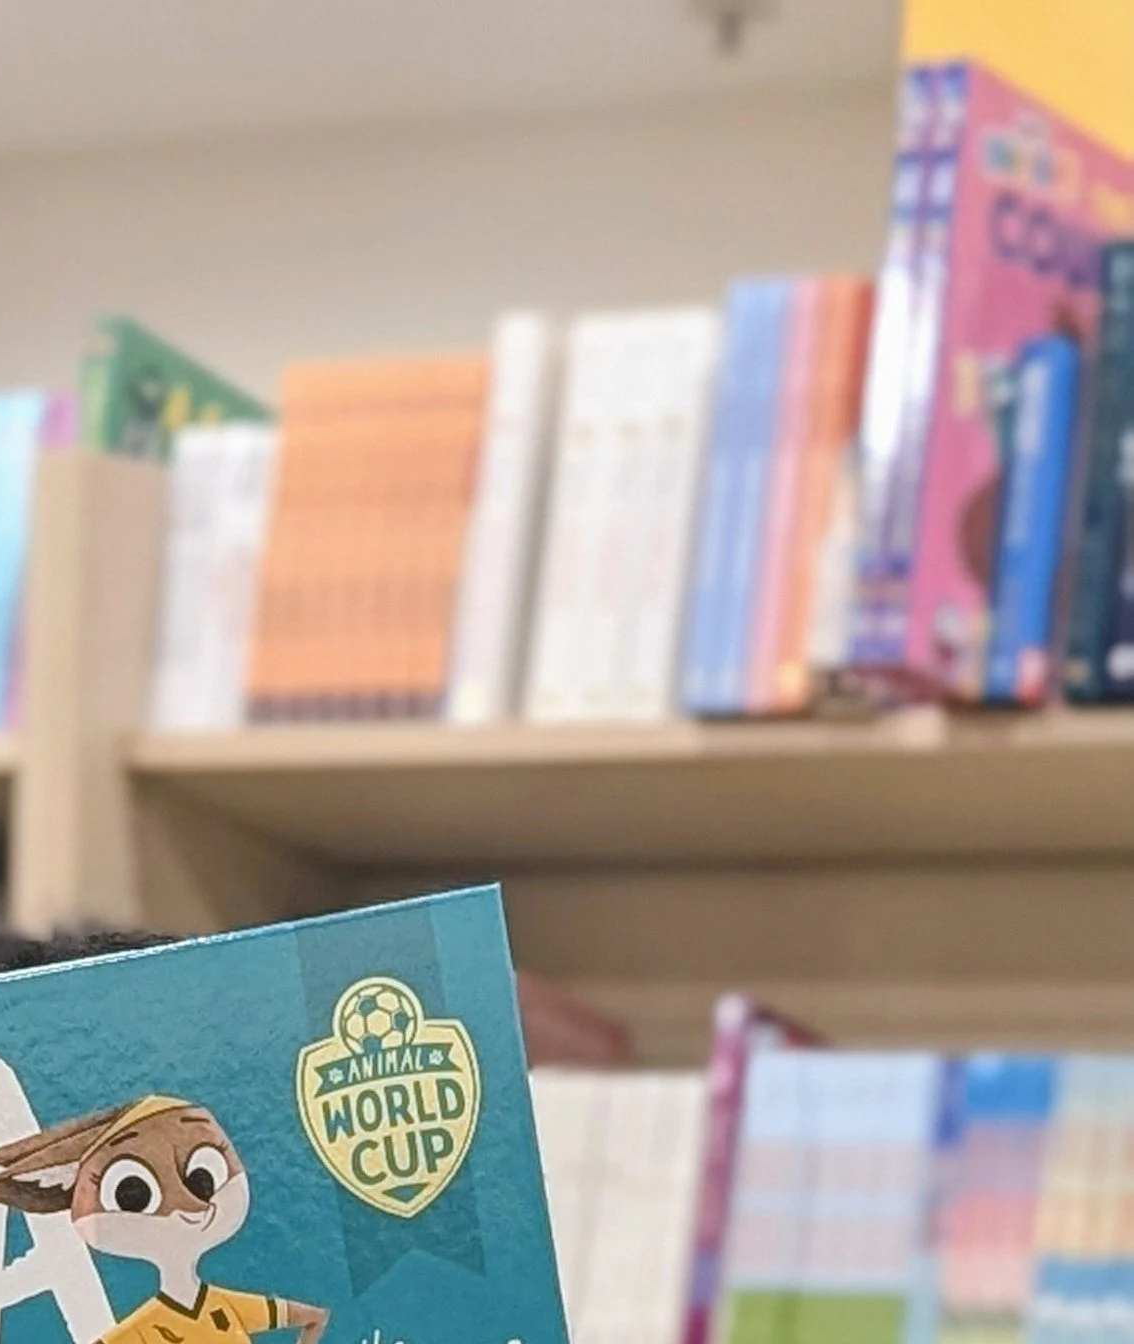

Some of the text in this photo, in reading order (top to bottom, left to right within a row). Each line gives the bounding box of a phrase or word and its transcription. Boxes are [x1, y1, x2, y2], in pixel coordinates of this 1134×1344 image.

[347, 1047, 425, 1084] ANIMAL
[322, 1078, 466, 1144] WORLD
[351, 1127, 454, 1186] CUP
